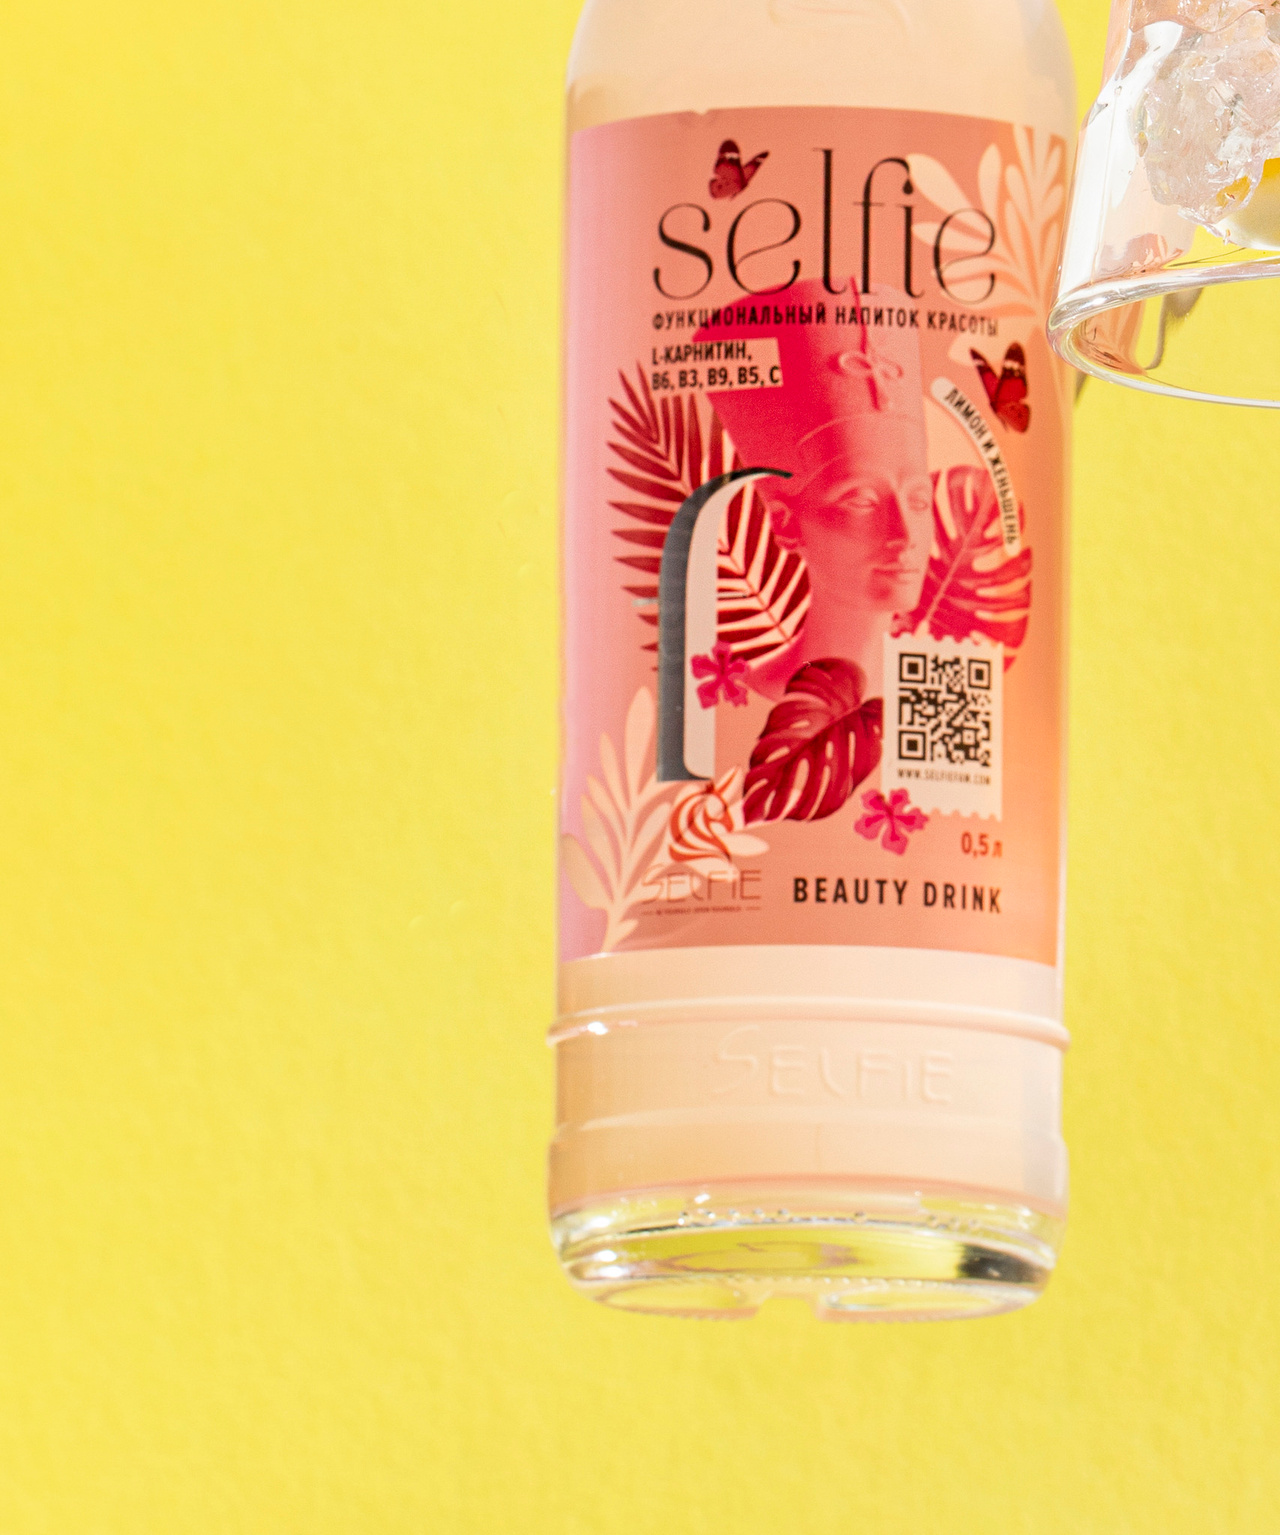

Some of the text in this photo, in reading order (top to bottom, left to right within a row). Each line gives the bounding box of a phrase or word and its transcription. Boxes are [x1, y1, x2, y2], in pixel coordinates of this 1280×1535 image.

[652, 147, 996, 305] selfie
[652, 302, 999, 337] ФУНКЦИОНАЛЬНЫЙ НАПИТОК КРАСОТЫ
[652, 341, 752, 365] L-КАРНИТИН,
[944, 387, 988, 441] ЛИМОН
[989, 454, 1019, 546] ЖЕНЬШЕНЬ
[960, 831, 989, 858] 0,5
[793, 876, 1002, 914] BEAUTY DRINK
